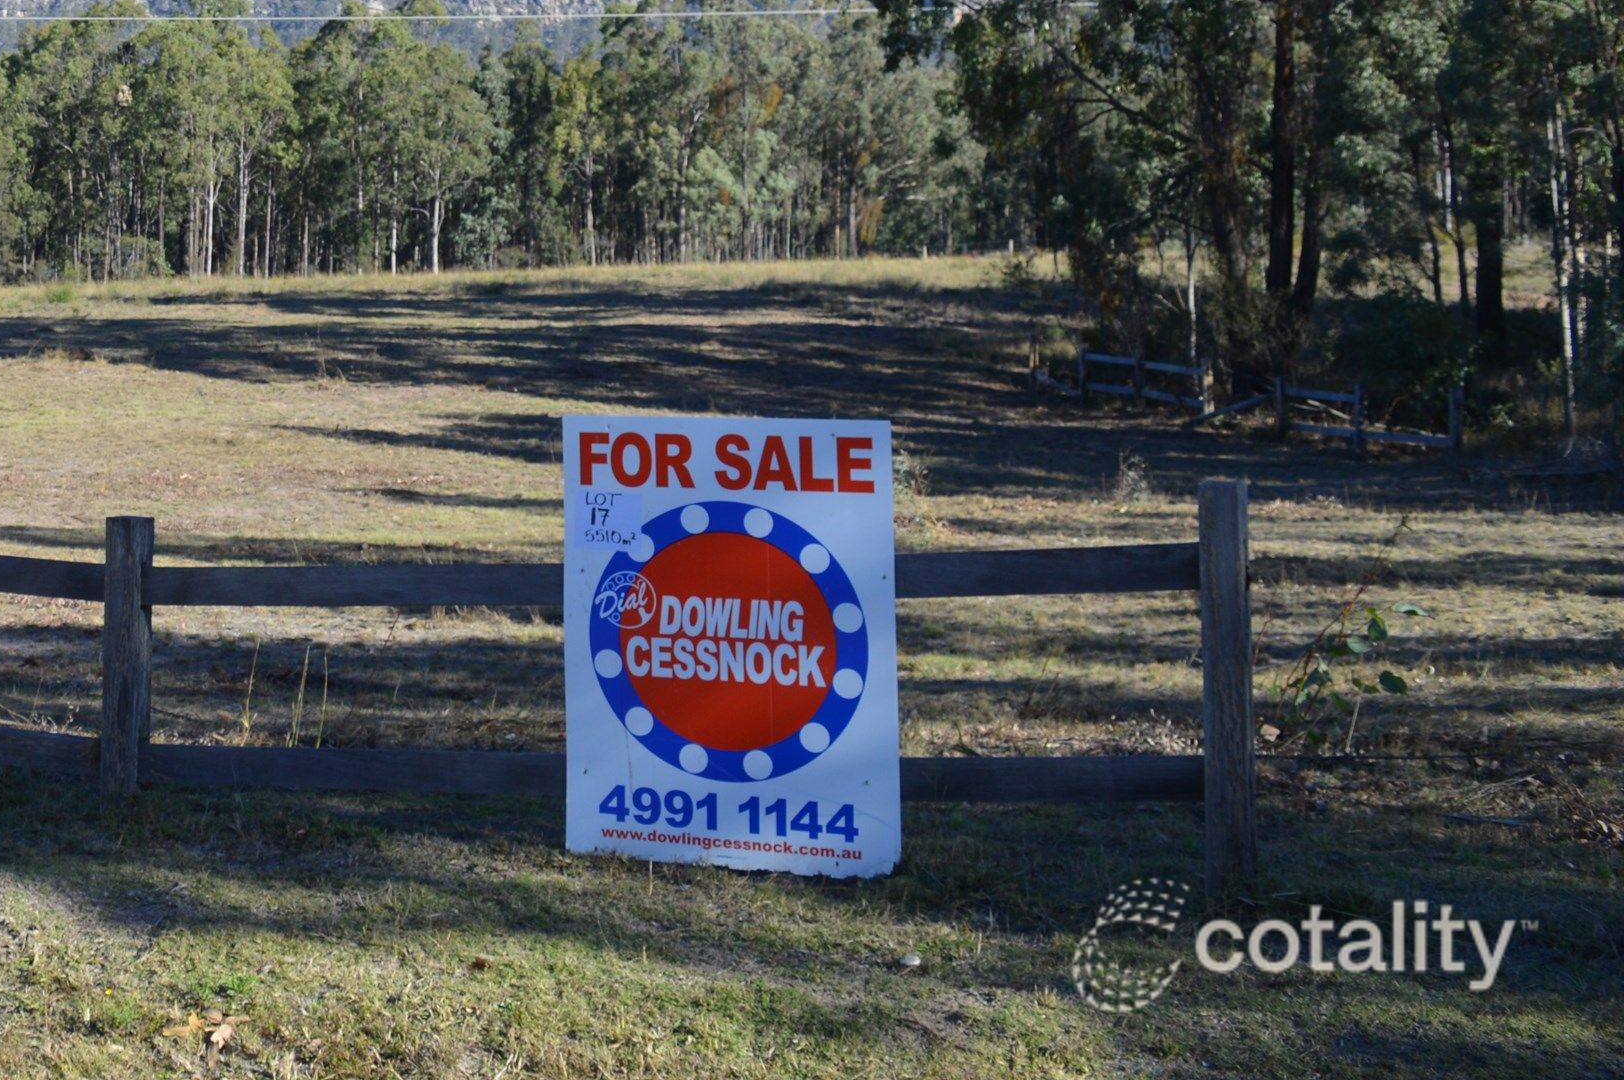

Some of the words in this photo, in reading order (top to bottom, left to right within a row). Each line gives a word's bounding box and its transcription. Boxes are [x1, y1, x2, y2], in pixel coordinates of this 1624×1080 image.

[579, 431, 696, 489] FOR
[714, 434, 875, 493] SALE
[585, 491, 622, 507] LOT
[590, 507, 610, 526] 17
[595, 581, 647, 619] Dial
[659, 595, 805, 641] DOWLING
[626, 635, 826, 688] CESSNOCK
[598, 784, 718, 831] 4991
[738, 796, 859, 843] 1144
[601, 826, 862, 860] www.dowlingcessnock.com.au
